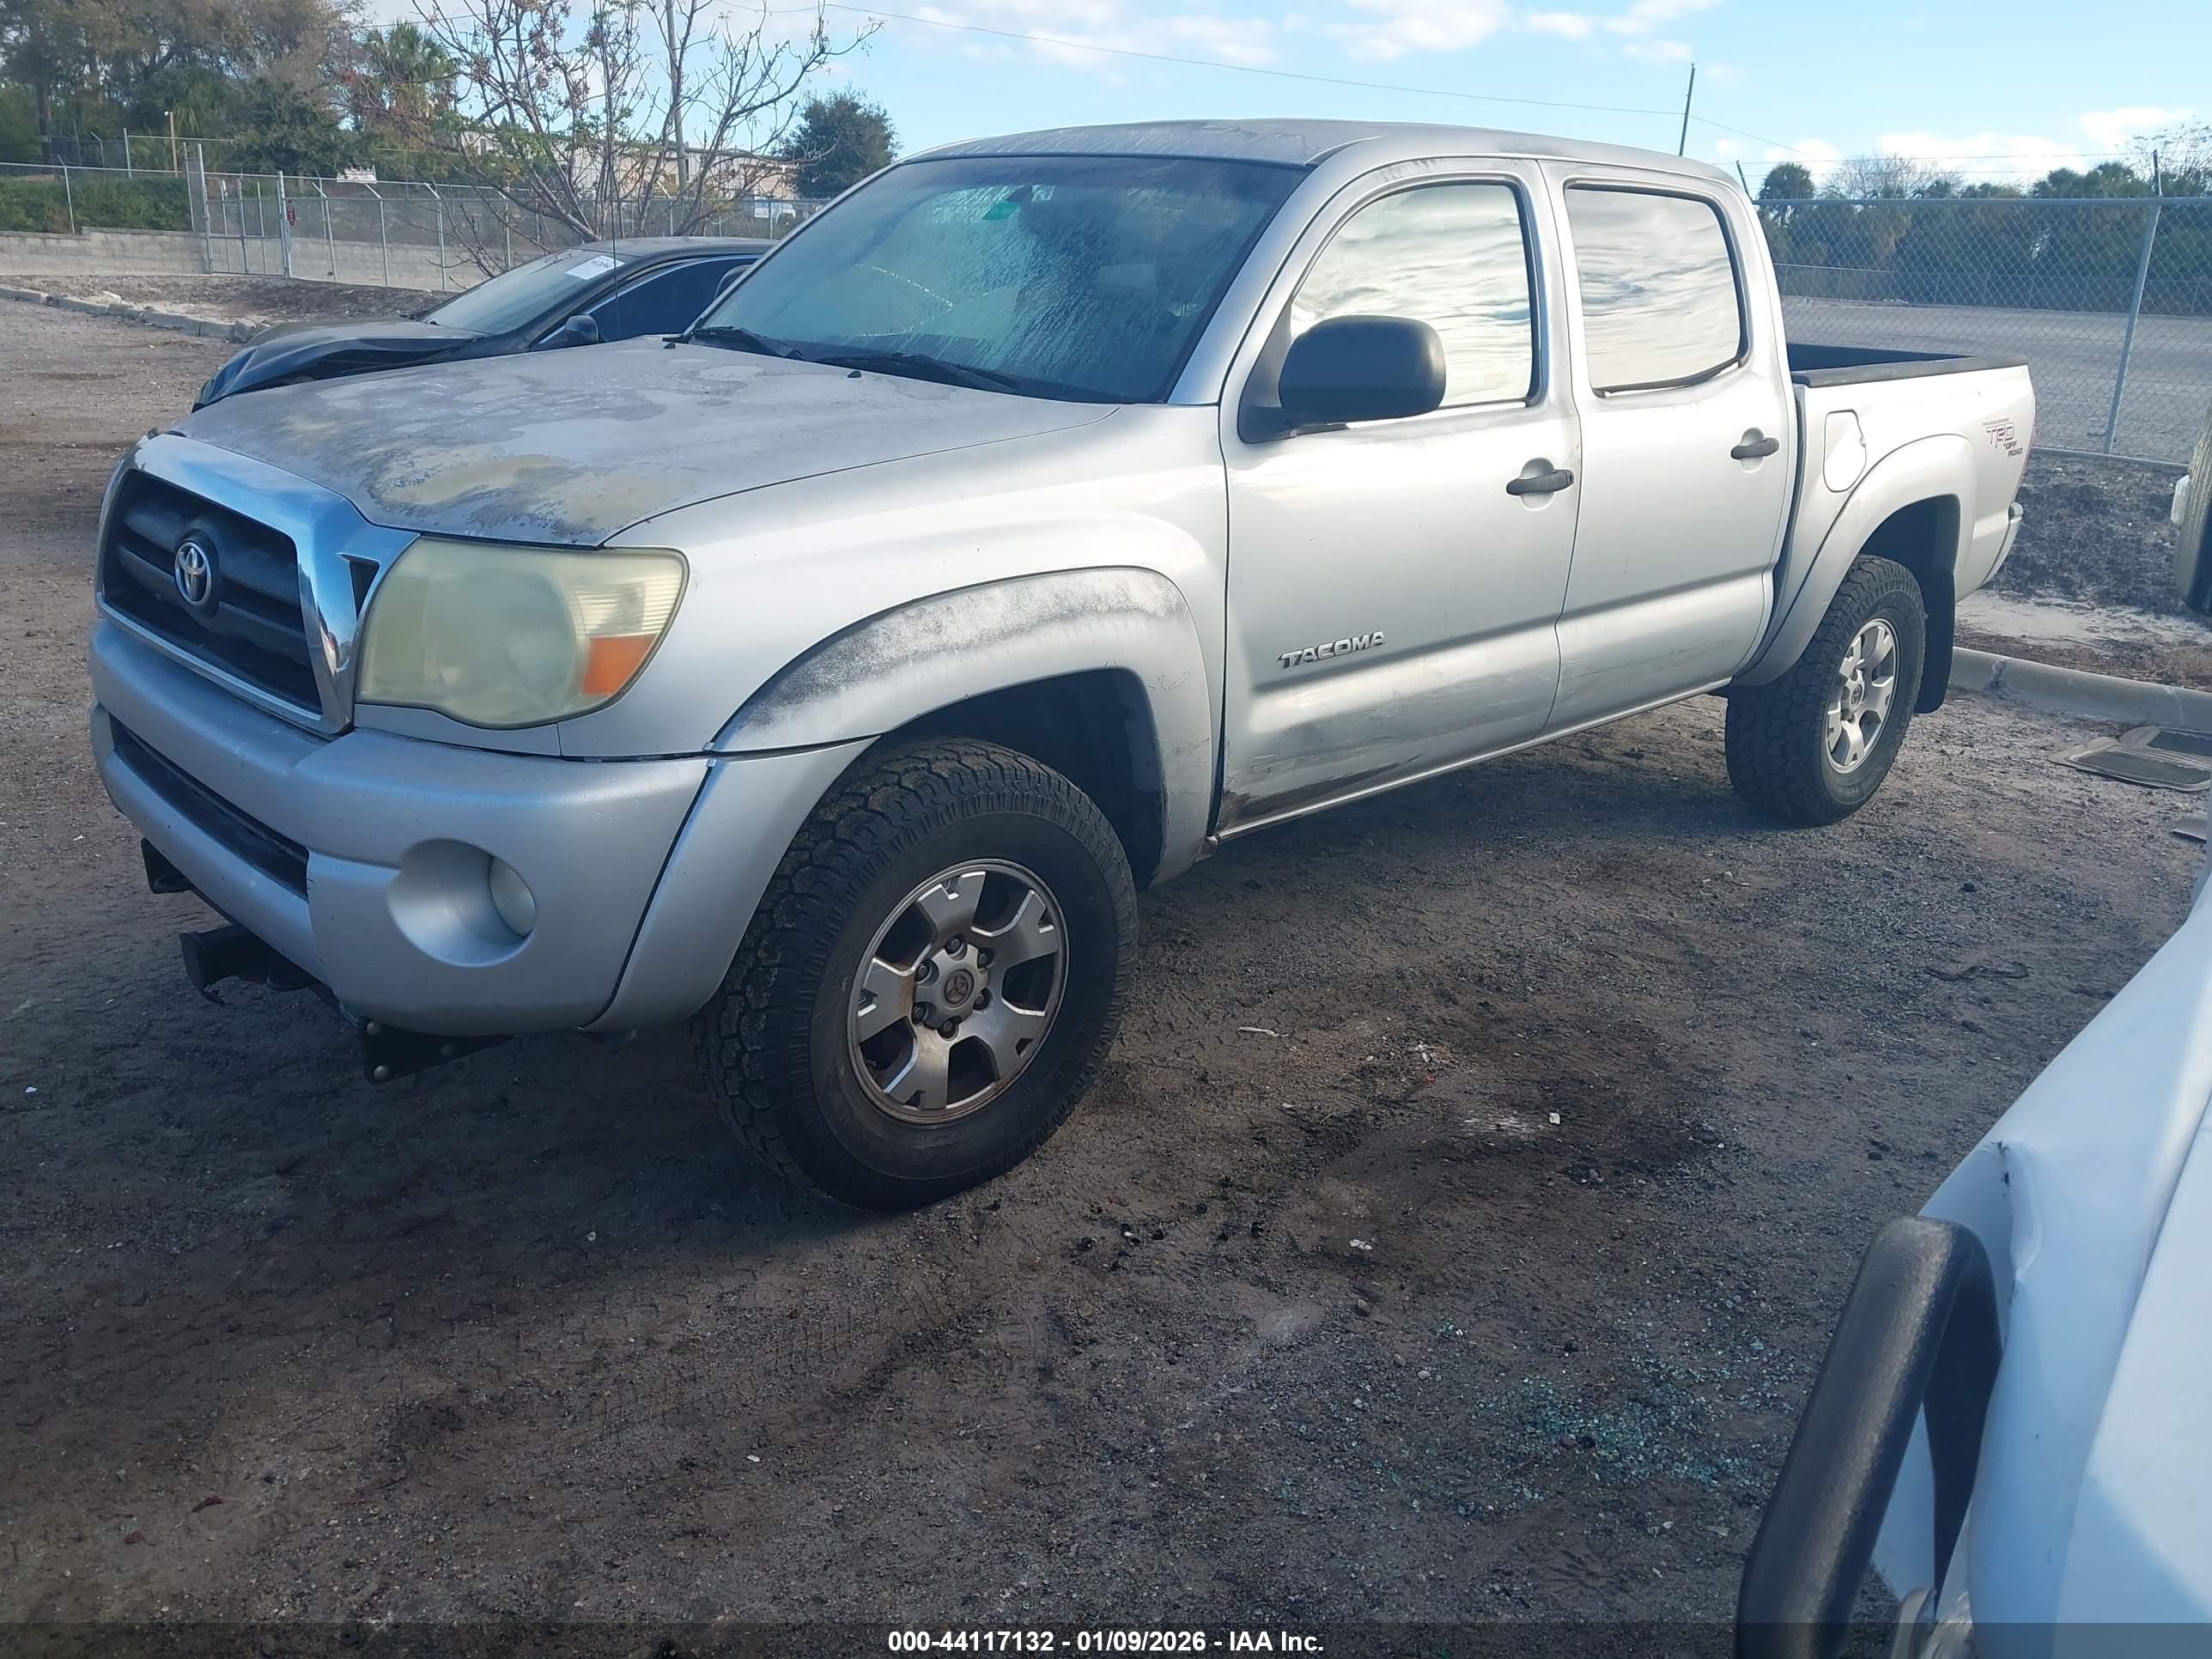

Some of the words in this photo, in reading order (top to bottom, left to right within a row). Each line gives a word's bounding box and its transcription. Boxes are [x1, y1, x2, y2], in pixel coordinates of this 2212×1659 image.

[1985, 422, 2014, 448] TRD
[2005, 441, 2017, 450] OFF
[2008, 447, 2023, 458] ROAD
[1278, 631, 1387, 668] TACOMA
